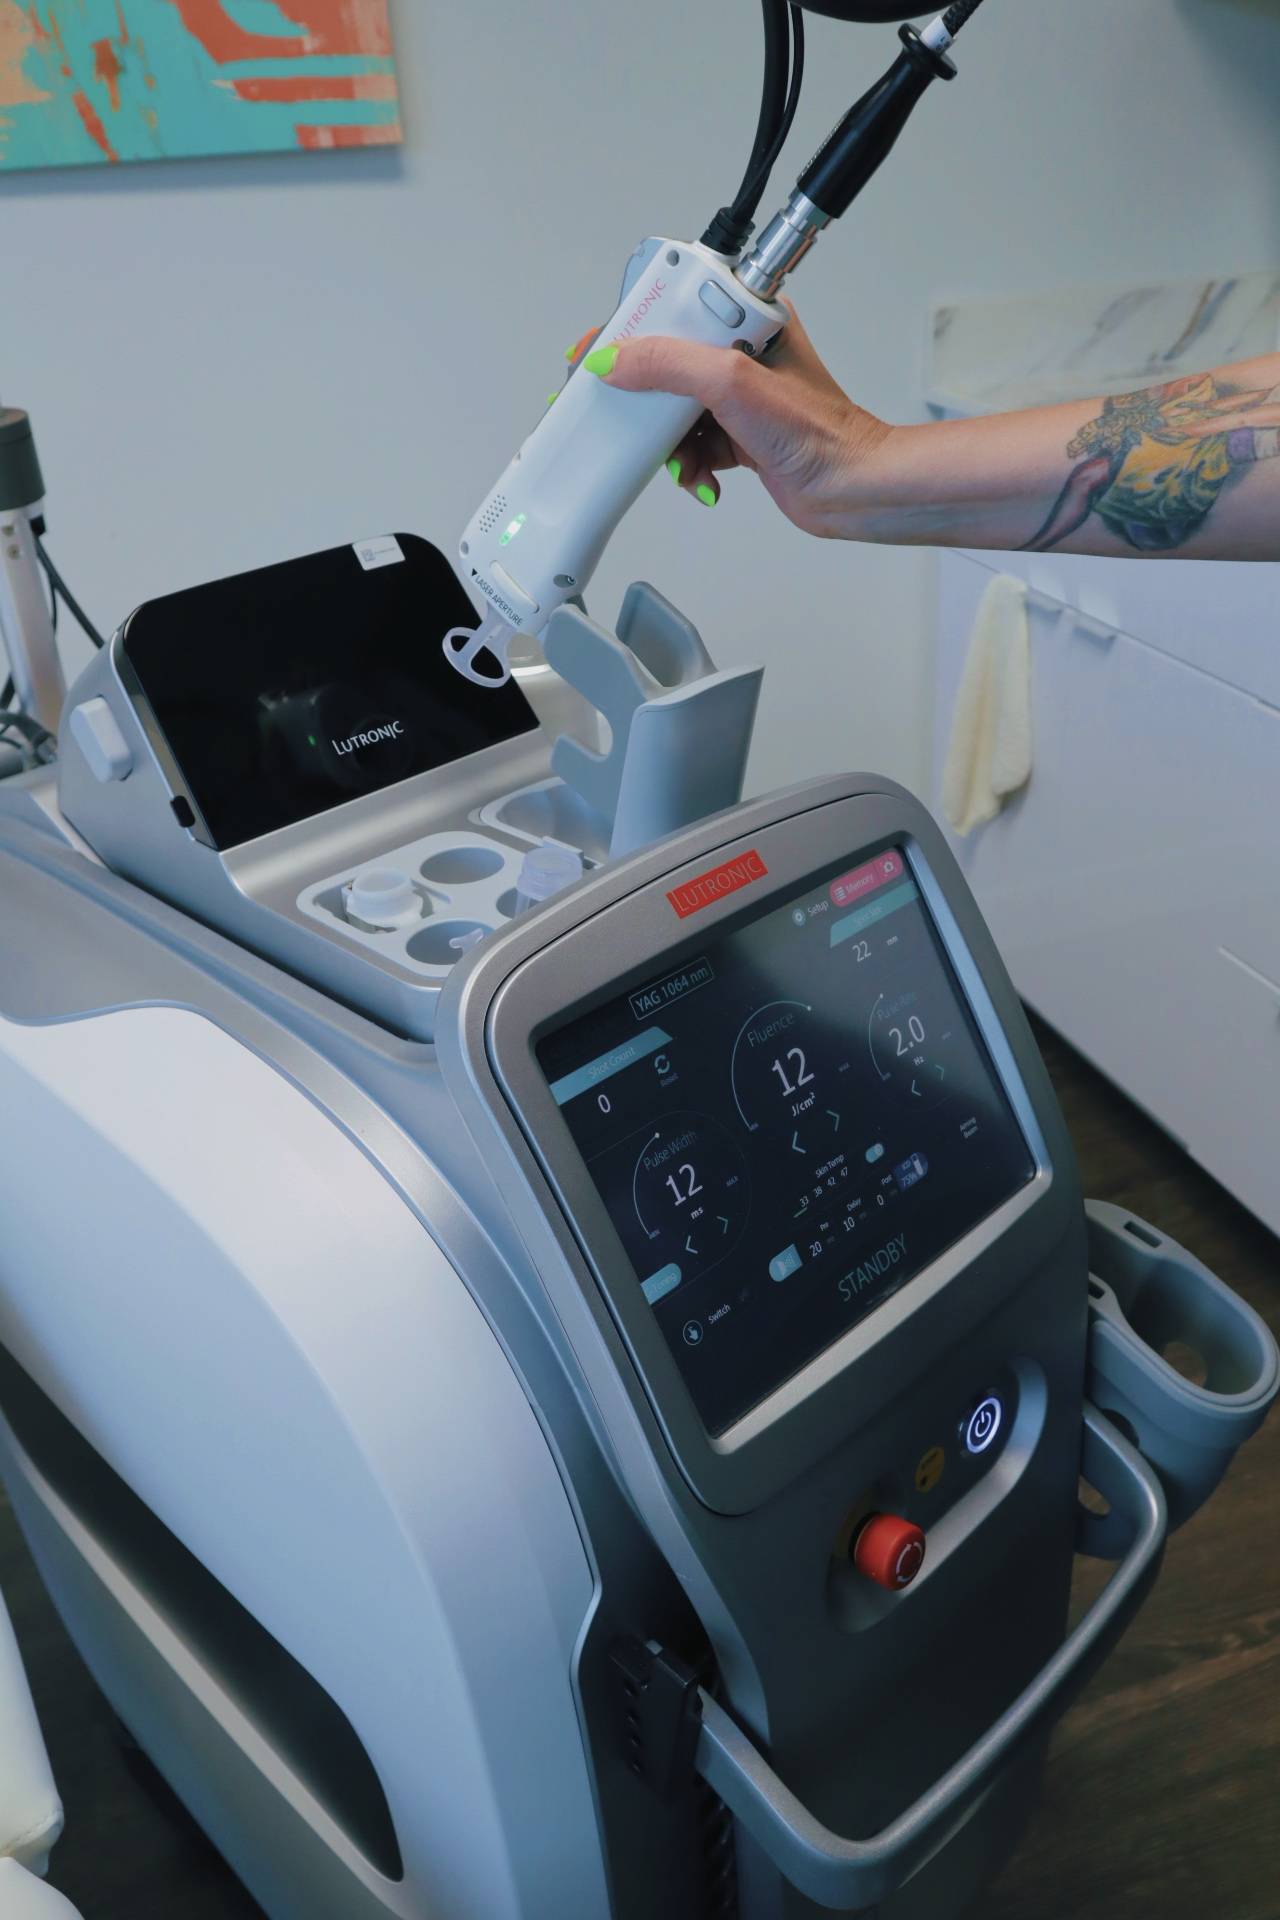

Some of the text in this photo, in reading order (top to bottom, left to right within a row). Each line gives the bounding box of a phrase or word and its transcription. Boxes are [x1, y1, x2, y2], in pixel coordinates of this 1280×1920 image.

[613, 278, 666, 340] UTRONIC
[475, 575, 523, 626] LASER APERTURE
[331, 720, 404, 756] LUTRONIC
[671, 856, 761, 912] LUTRONIC
[845, 873, 875, 893] Memory
[807, 900, 829, 917] Setup
[852, 940, 872, 962] 22
[635, 966, 709, 1012] YAG 1064 nm
[747, 1013, 795, 1047] Fluence
[889, 1016, 925, 1056] 2.0
[587, 1047, 636, 1079] Shot Count
[772, 1047, 815, 1097] 12
[914, 1056, 925, 1066] Hz
[597, 1094, 611, 1113] 0
[643, 1130, 697, 1171] Pulse Width
[815, 1154, 845, 1178] Skin Temp
[666, 1163, 703, 1206] 12
[800, 1166, 848, 1207] 33 38 42 47
[877, 1194, 884, 1206] 0
[690, 1207, 704, 1220] ms
[843, 1216, 855, 1232] 10
[809, 1241, 823, 1257] 20
[838, 1233, 907, 1302] STANDBY
[708, 1304, 731, 1325] Switch
